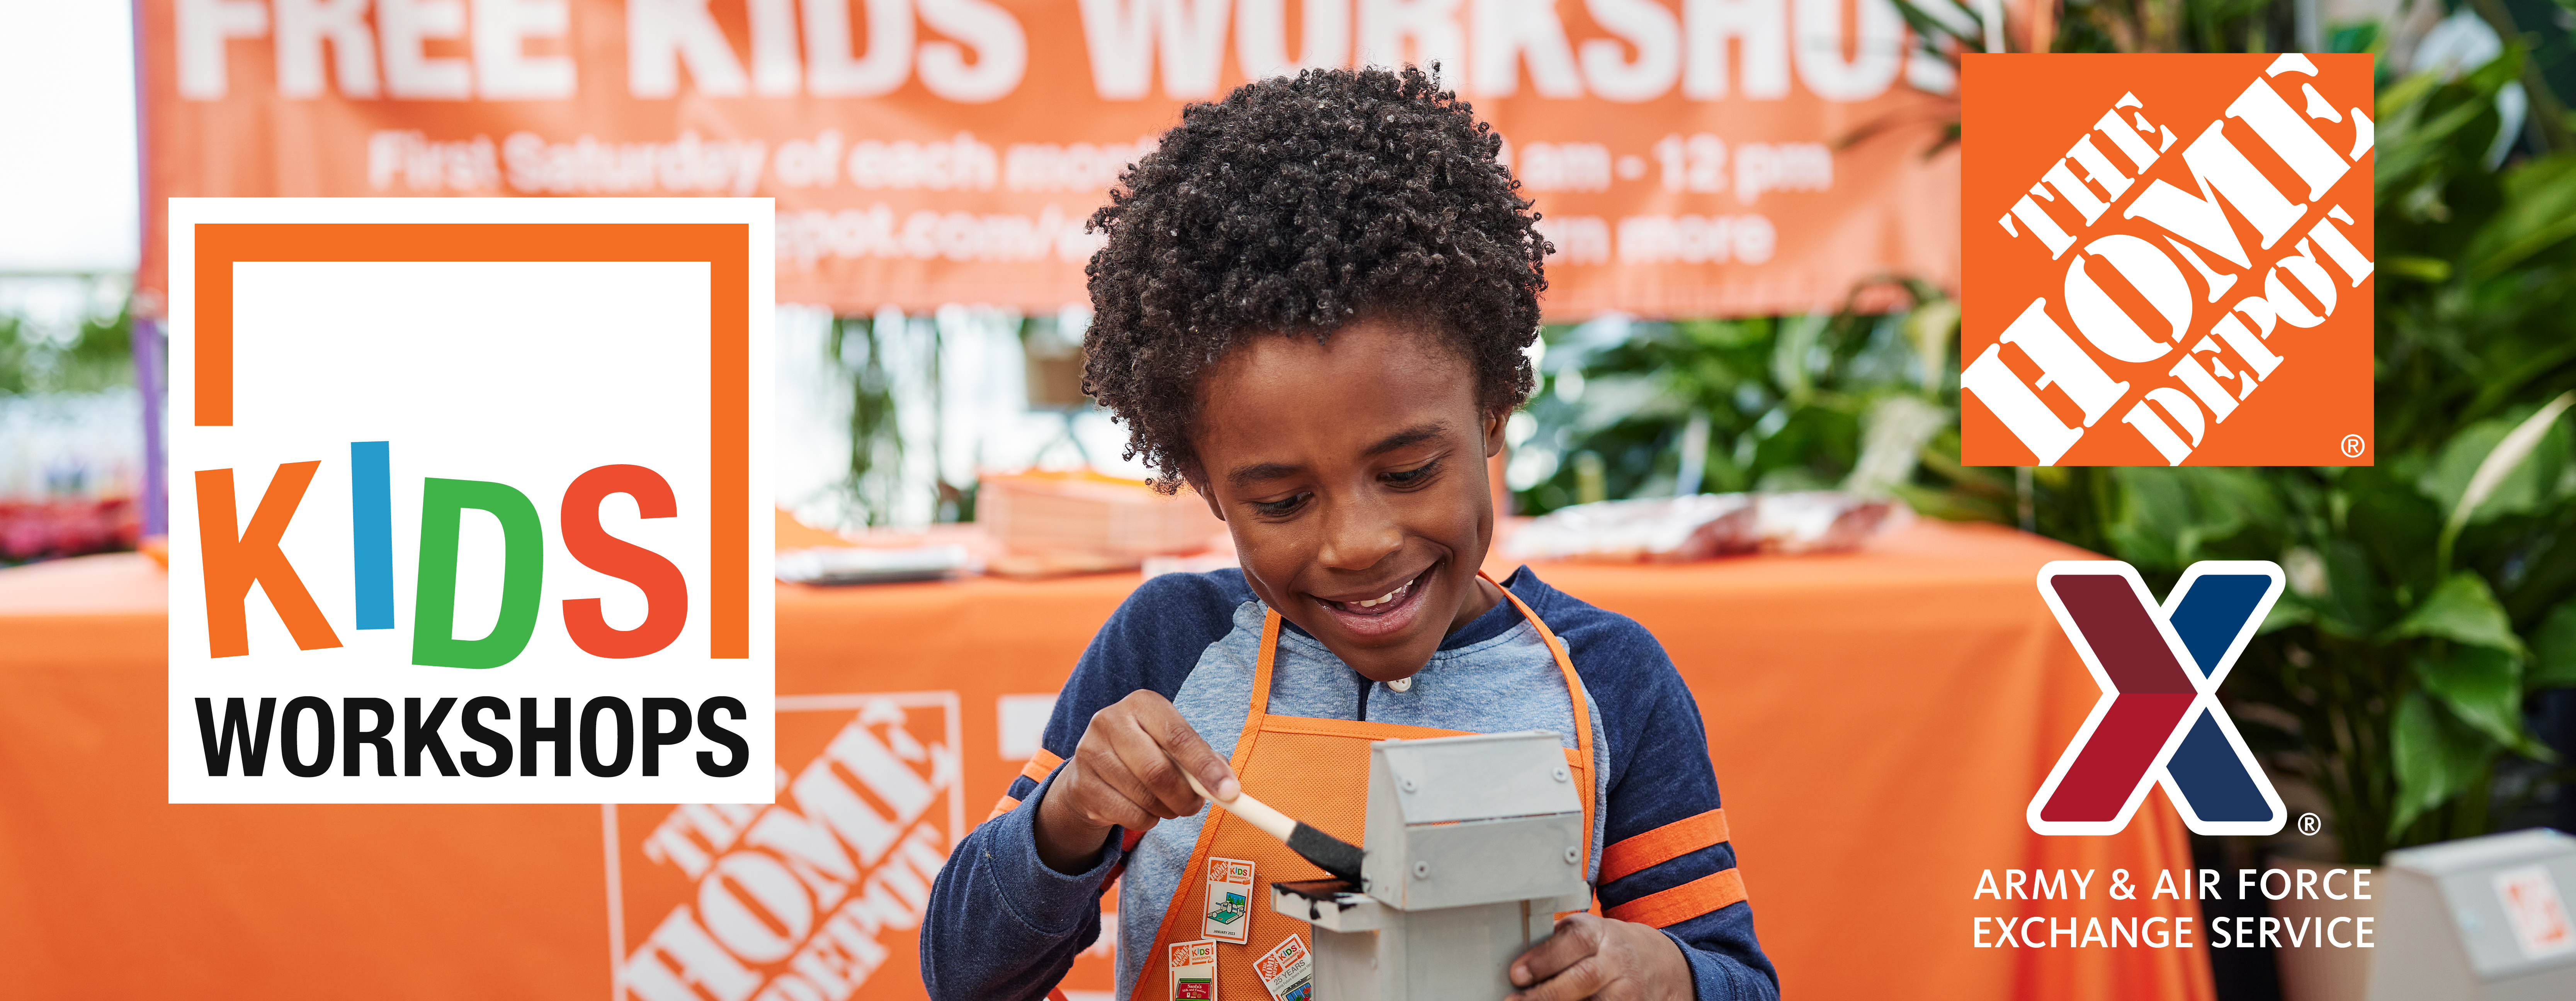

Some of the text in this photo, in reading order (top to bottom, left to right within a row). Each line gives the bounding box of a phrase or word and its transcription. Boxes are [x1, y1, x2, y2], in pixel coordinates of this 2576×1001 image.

[176, 0, 1958, 102] FREE KIDS WORKSHO
[369, 130, 501, 189] First
[503, 131, 767, 197] Saturday
[775, 128, 843, 189] of
[851, 131, 999, 191] each
[1519, 141, 1612, 193] am
[1652, 133, 1728, 194] 12
[1734, 141, 1834, 205] pm
[1617, 213, 1778, 266] more
[1210, 860, 1228, 881] HOME
[1212, 862, 1220, 870] THE
[1216, 869, 1228, 881] DEPOT
[1230, 867, 1248, 876] KIDS
[1172, 945, 1189, 967] HOME
[1192, 948, 1210, 957] KIDS
[1278, 945, 1297, 961] KIDS
[1282, 951, 1299, 964] WORKSHOPS
[1265, 955, 1275, 980] HOME
[1274, 960, 1305, 986] 25 YEARS
[1273, 984, 1284, 993] Building
